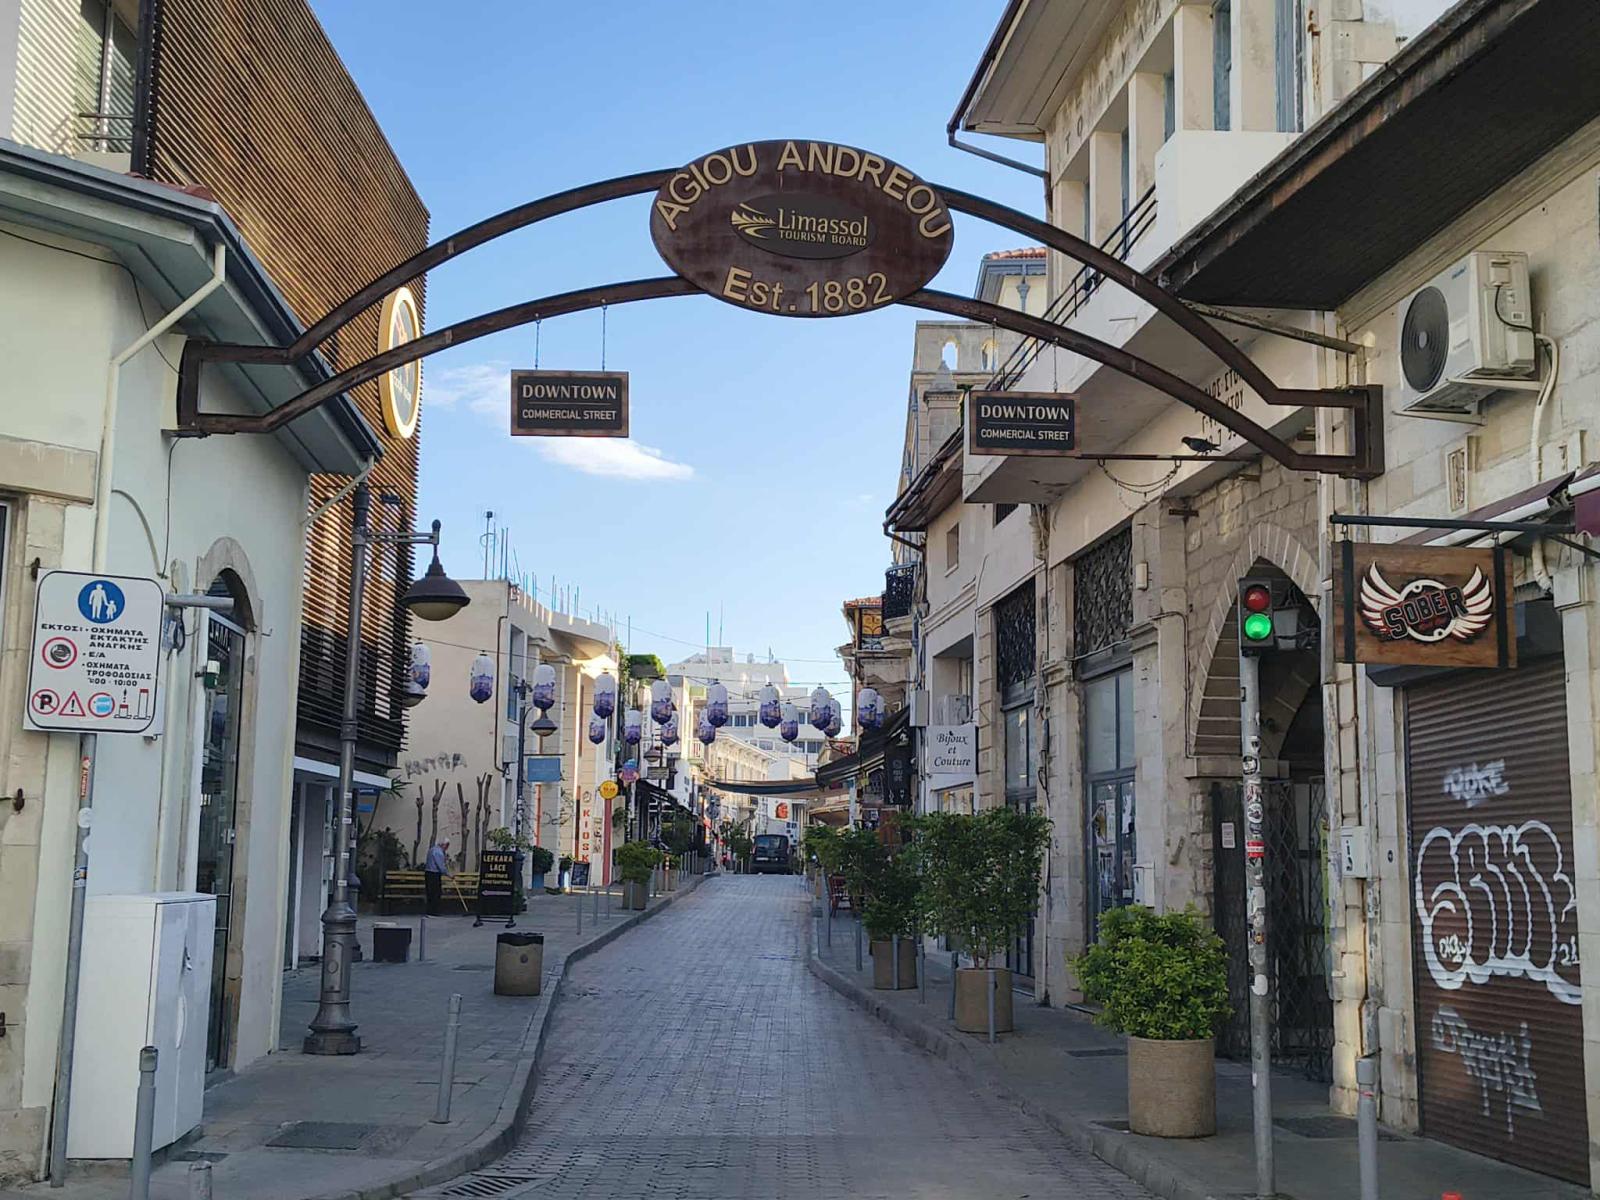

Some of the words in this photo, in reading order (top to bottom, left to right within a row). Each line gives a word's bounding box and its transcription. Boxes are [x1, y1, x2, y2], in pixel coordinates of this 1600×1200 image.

[655, 144, 758, 231] AGIOU
[776, 141, 951, 238] ANDREOU
[778, 208, 868, 237] Limassol
[779, 230, 826, 244] TOURISM
[831, 235, 867, 247] BOARD
[722, 266, 798, 312] Est.
[805, 272, 893, 312] 1882
[522, 384, 617, 400] DOWNTOWN
[522, 409, 581, 420] COMMERCIAL
[583, 410, 617, 421] STREET
[981, 404, 1070, 420] DOWNTOWN
[980, 428, 1036, 440] COMMERCIAL
[1038, 430, 1070, 441] STREET
[1384, 586, 1470, 640] SOBER
[41, 623, 83, 632] ΕΚΤΟΣ:
[91, 627, 144, 637] ΟΧΗΜΑΤΑ
[90, 634, 149, 644] ΕΚΤΑΚΤΗΣ
[89, 642, 143, 651] ΑΝΑΓΚΗΣ
[86, 661, 130, 671] ΟΧΗΜΑΤΑ
[86, 670, 152, 680] ΤΡΟΦΟΔΟΣΙΑΣ
[936, 732, 969, 746] Bijoux
[947, 746, 957, 755] et
[934, 756, 971, 767] Couture
[581, 809, 591, 864] KIOSK
[482, 855, 513, 863] LEFKARA
[489, 864, 506, 872] LACE
